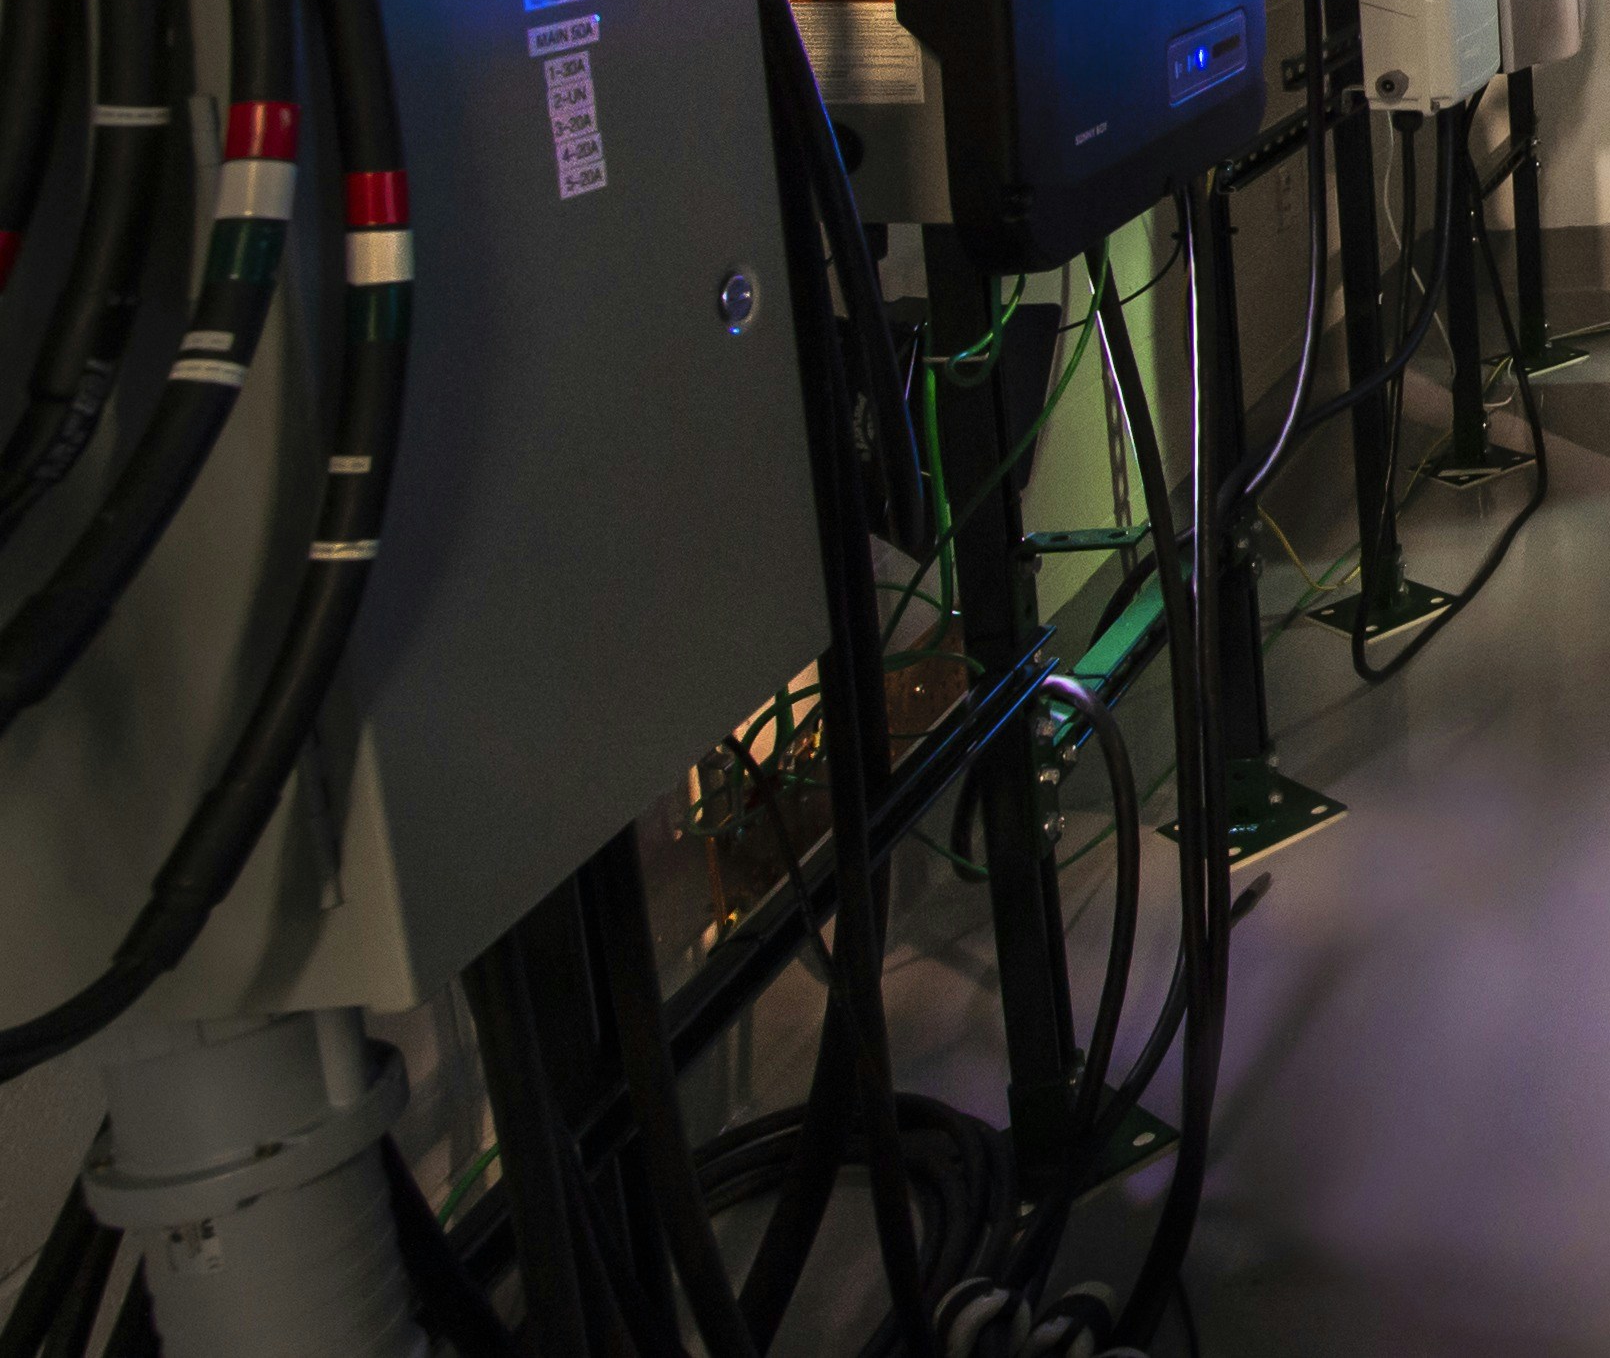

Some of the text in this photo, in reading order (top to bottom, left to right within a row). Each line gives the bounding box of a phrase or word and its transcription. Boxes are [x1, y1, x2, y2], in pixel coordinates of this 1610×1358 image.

[535, 22, 594, 47] MAIN 50A
[552, 86, 588, 109] 2-UN
[554, 113, 592, 137] 3-20A
[562, 140, 599, 162] 4-20A
